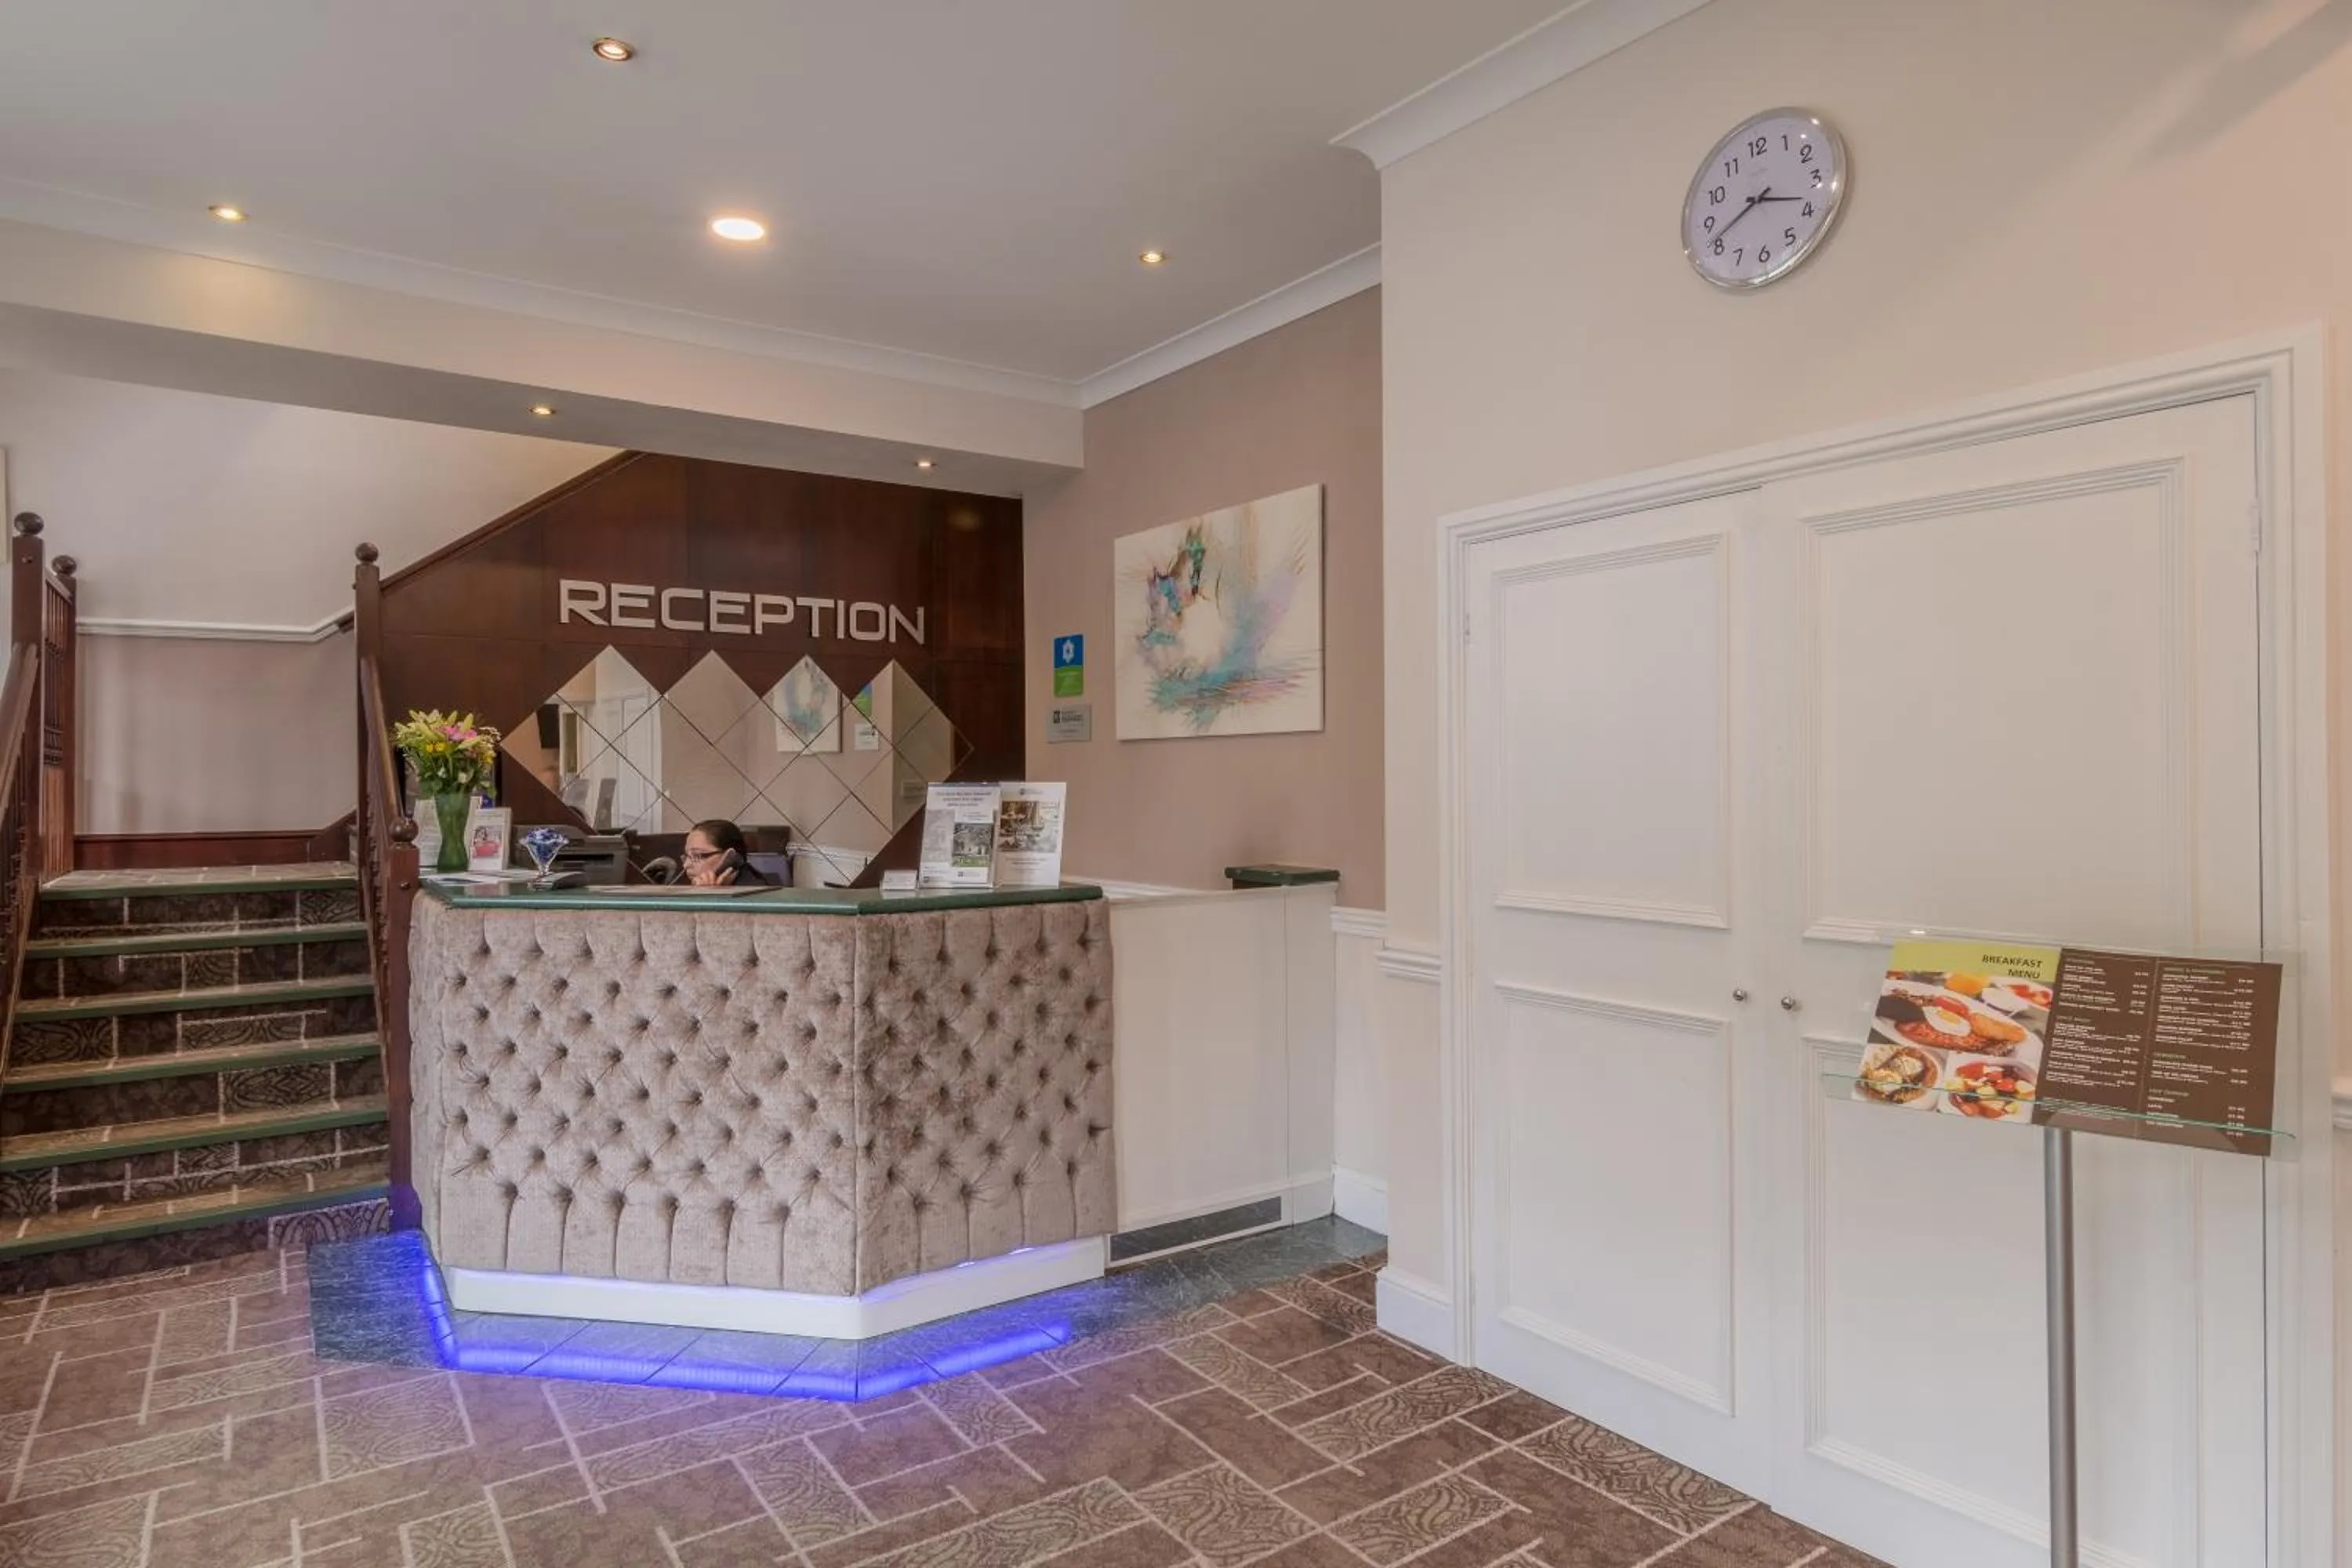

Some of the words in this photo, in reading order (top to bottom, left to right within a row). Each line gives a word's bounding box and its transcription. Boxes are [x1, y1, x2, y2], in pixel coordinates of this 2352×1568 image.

[1748, 136, 1768, 158] 12
[1781, 134, 1789, 151] 1
[1799, 144, 1813, 164] 2
[1724, 158, 1740, 178] 11
[1809, 169, 1822, 189] 3
[1707, 185, 1726, 206] 10
[1801, 201, 1815, 218] 4
[1704, 216, 1715, 234] 9
[1713, 237, 1725, 256] 8
[1784, 227, 1797, 247] 5
[1732, 248, 1744, 267] 7
[1758, 245, 1771, 263] 6
[559, 579, 925, 644] RECEPTION
[1981, 954, 2043, 968] BREAKFAST
[2007, 968, 2042, 979] MENU
